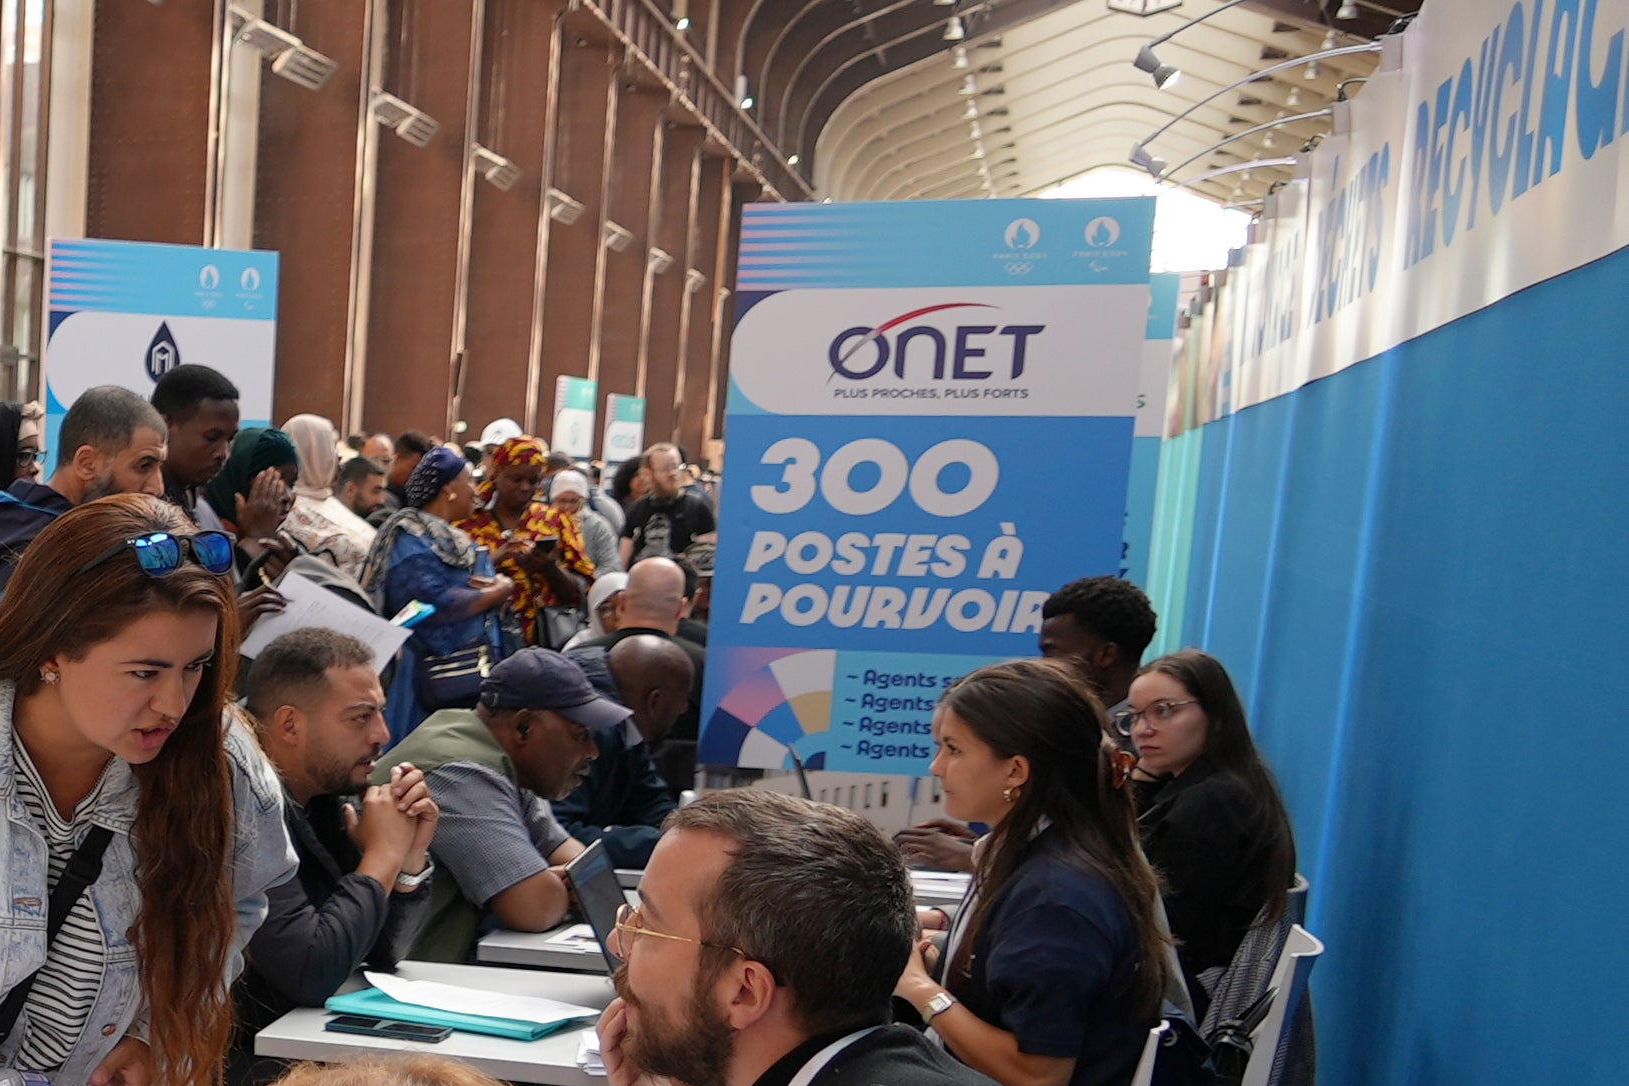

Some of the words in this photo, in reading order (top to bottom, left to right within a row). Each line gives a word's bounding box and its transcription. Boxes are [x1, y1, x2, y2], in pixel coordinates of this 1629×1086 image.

[1403, 0, 1629, 271] RECYCLAG
[833, 388, 868, 399] PLUS
[872, 388, 941, 400] PROCHES,
[944, 388, 980, 399] PLUS
[982, 388, 1030, 399] FORTS
[750, 437, 1000, 517] 300
[743, 530, 971, 577] POSTES
[977, 522, 1025, 579] À
[739, 583, 1052, 634] POURVOIR
[862, 669, 937, 689] Agents
[860, 693, 934, 712] Agents
[858, 716, 932, 736] Agents
[856, 739, 930, 760] Agents
